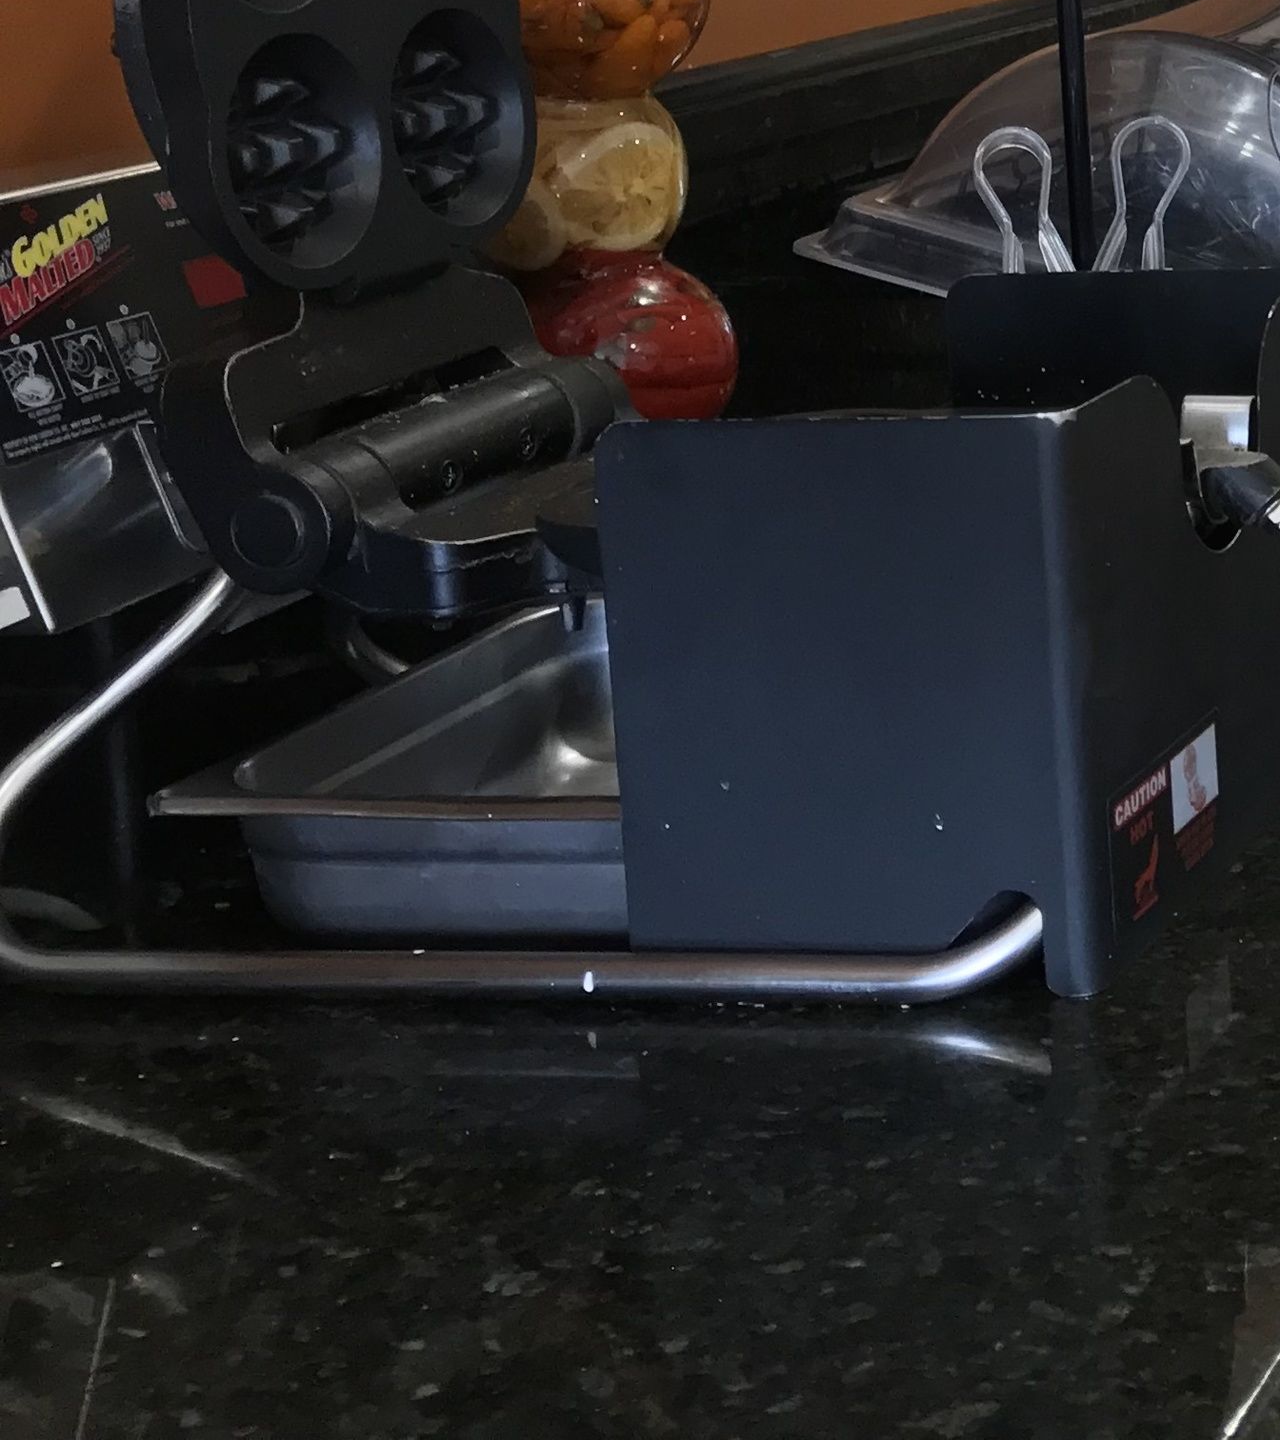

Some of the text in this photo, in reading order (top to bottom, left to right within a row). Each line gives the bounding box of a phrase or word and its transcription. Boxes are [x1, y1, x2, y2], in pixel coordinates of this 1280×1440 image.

[11, 193, 109, 278] GOLDEN
[0, 238, 96, 326] MALTED
[1114, 766, 1167, 827] CAUTION
